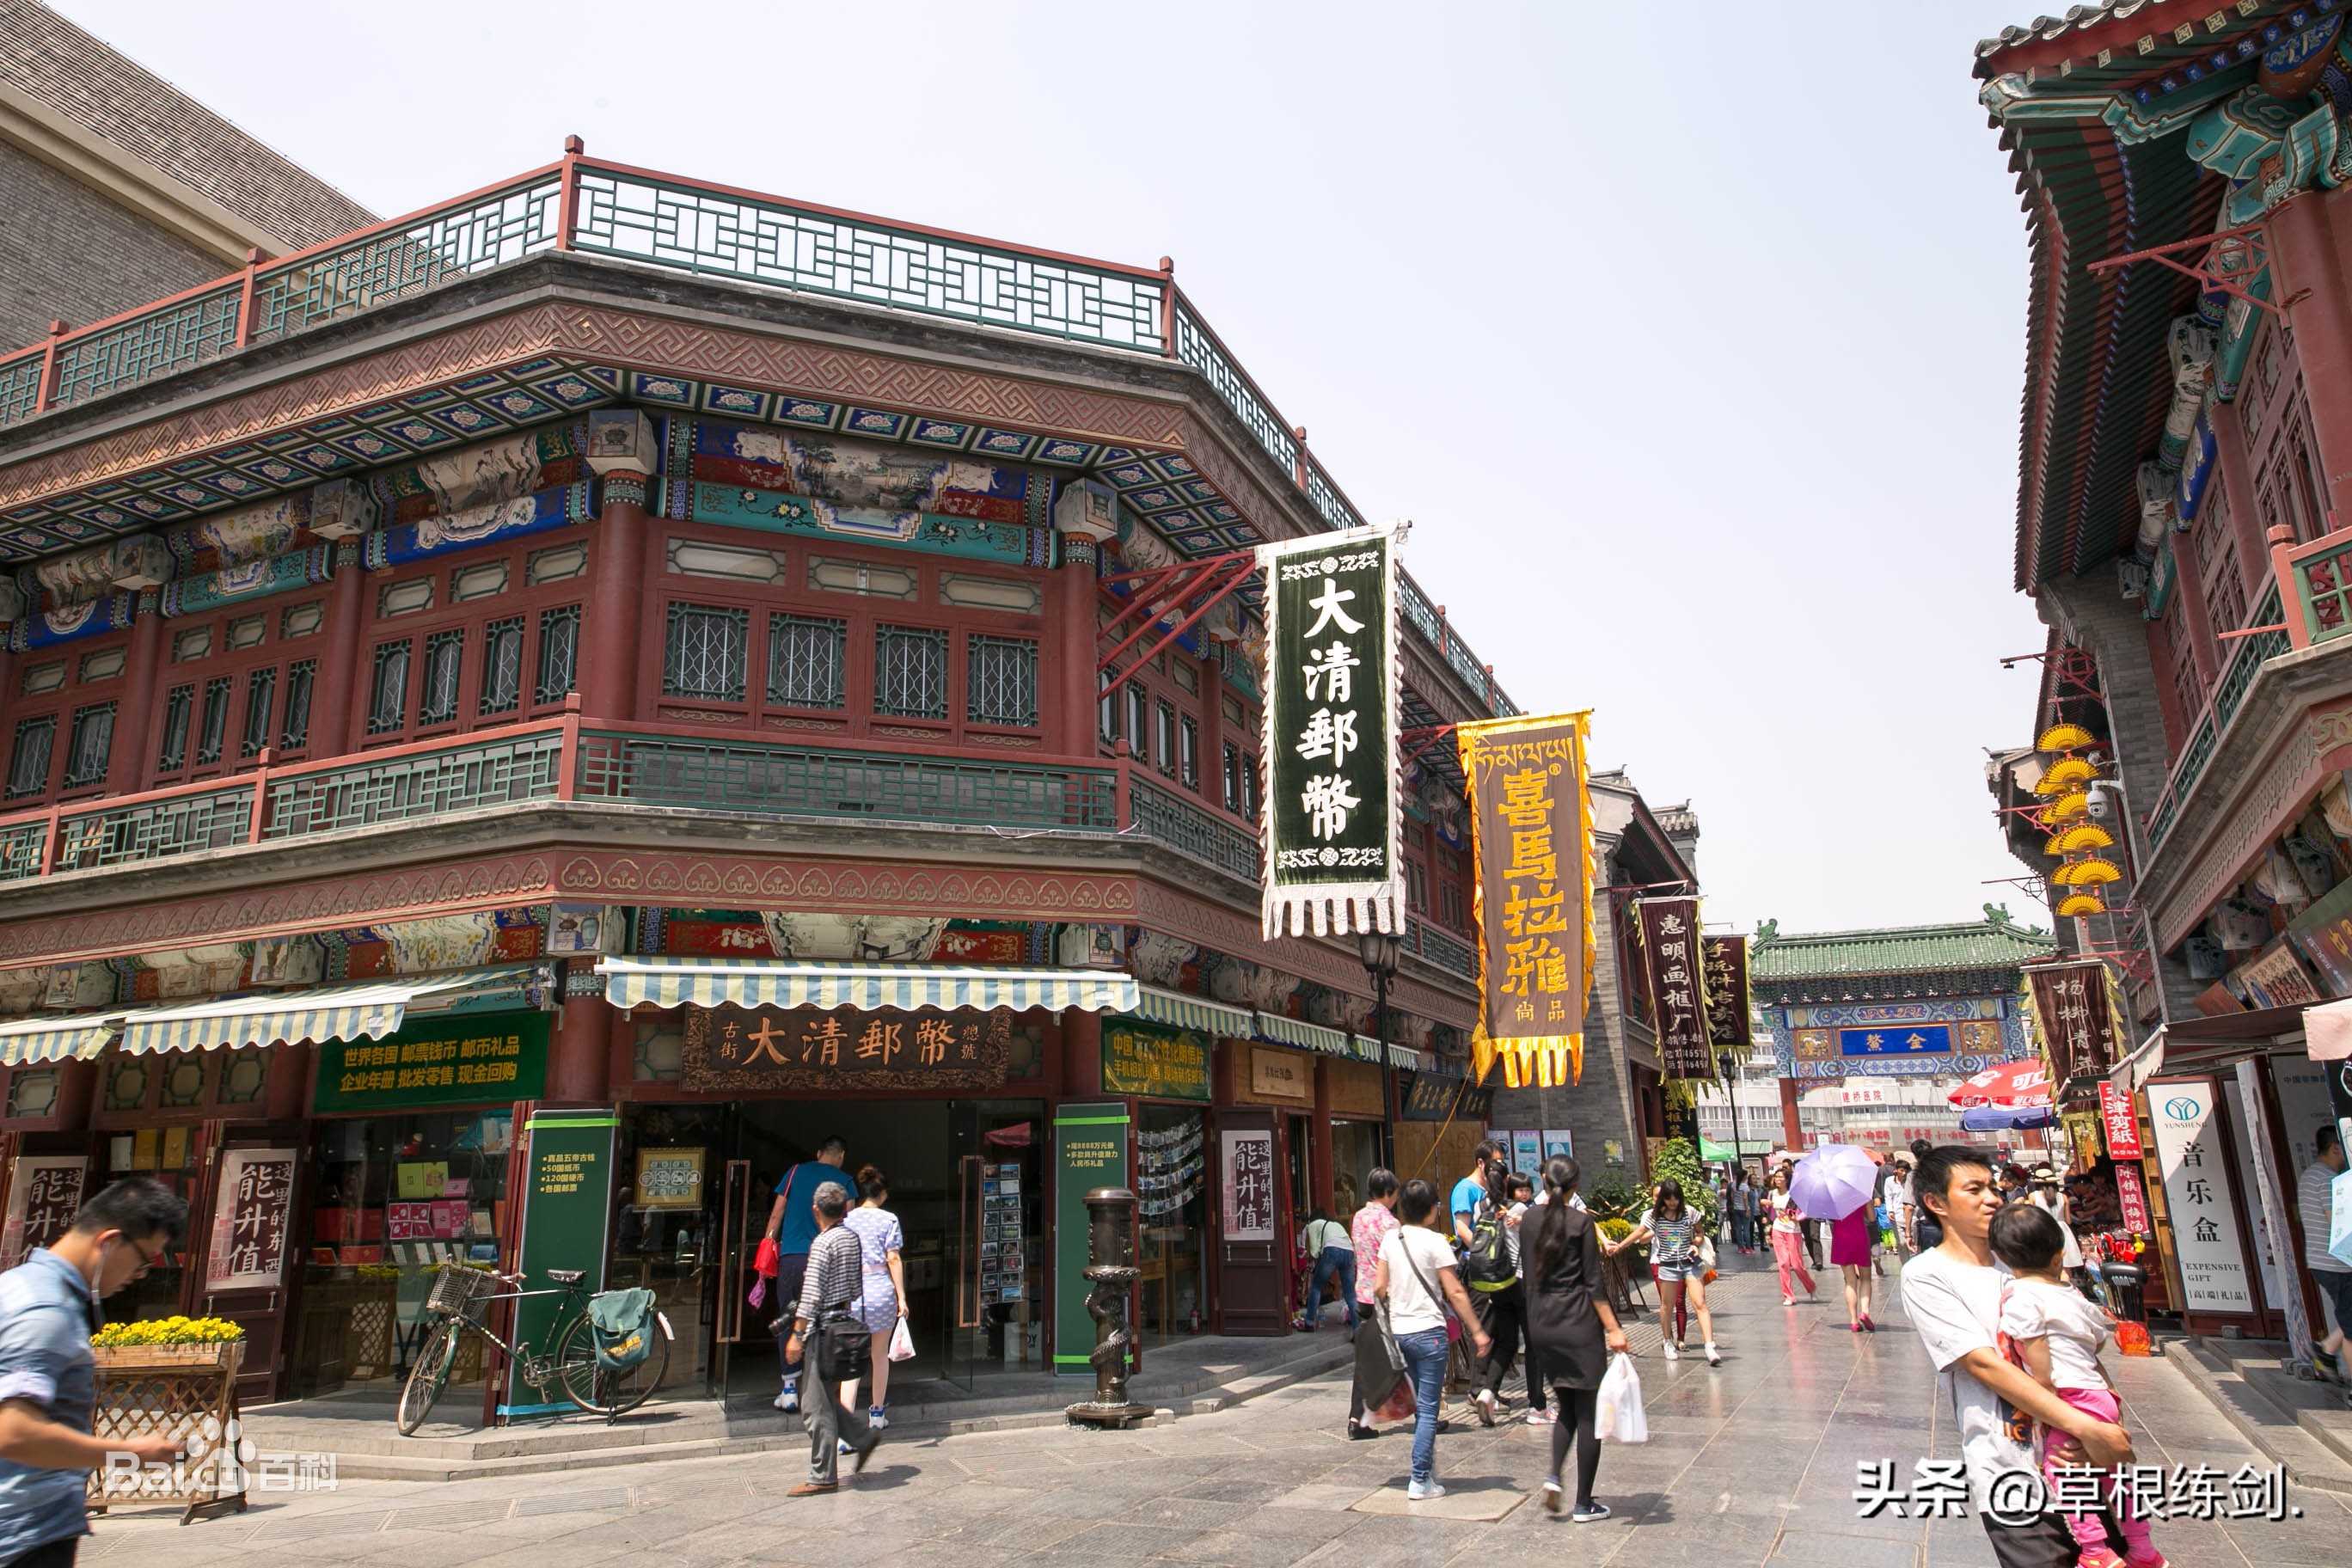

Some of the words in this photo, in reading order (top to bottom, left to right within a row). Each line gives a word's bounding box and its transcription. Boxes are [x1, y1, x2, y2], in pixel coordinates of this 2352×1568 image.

[1295, 577, 1365, 842] 大清郵幣
[1498, 768, 1569, 997] 喜馬拉雅
[1515, 999, 1565, 1022] 尚品
[1660, 914, 1694, 1032] 惠明画框厂
[340, 1070, 395, 1092] 企业年册
[397, 1067, 454, 1088] 批发零售
[457, 1061, 518, 1083] 现金回购
[344, 1044, 399, 1068] 世界各国
[401, 1040, 457, 1063] 邮票钱币
[460, 1035, 520, 1059] 邮币礼品
[720, 1020, 742, 1060] 古街
[741, 1016, 957, 1067] 大清郵幣
[229, 1165, 275, 1277] 能升值
[264, 1163, 291, 1275] 这里的东西
[1233, 1142, 1262, 1231] 能升值
[2177, 1141, 2221, 1242] 音乐盒
[2186, 1263, 2240, 1271] EXPENSIVE
